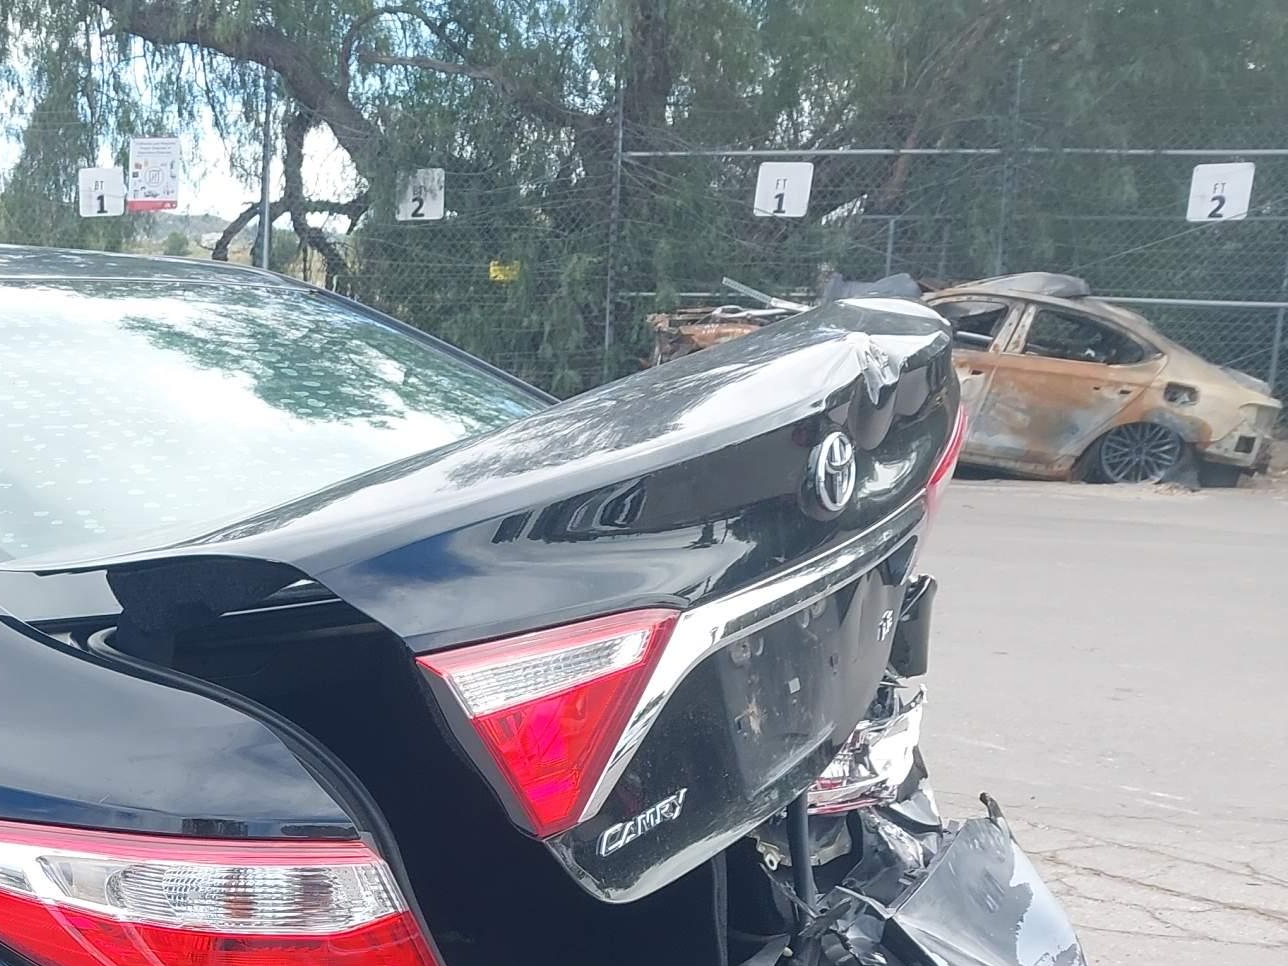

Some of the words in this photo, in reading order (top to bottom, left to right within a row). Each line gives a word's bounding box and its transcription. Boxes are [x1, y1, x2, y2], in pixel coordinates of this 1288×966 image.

[775, 178, 787, 189] FT
[1212, 182, 1226, 193] FT
[96, 194, 107, 213] 1
[411, 197, 424, 217] 2
[773, 192, 785, 213] 1
[1207, 194, 1226, 218] 2
[597, 788, 688, 857] CAMRY
